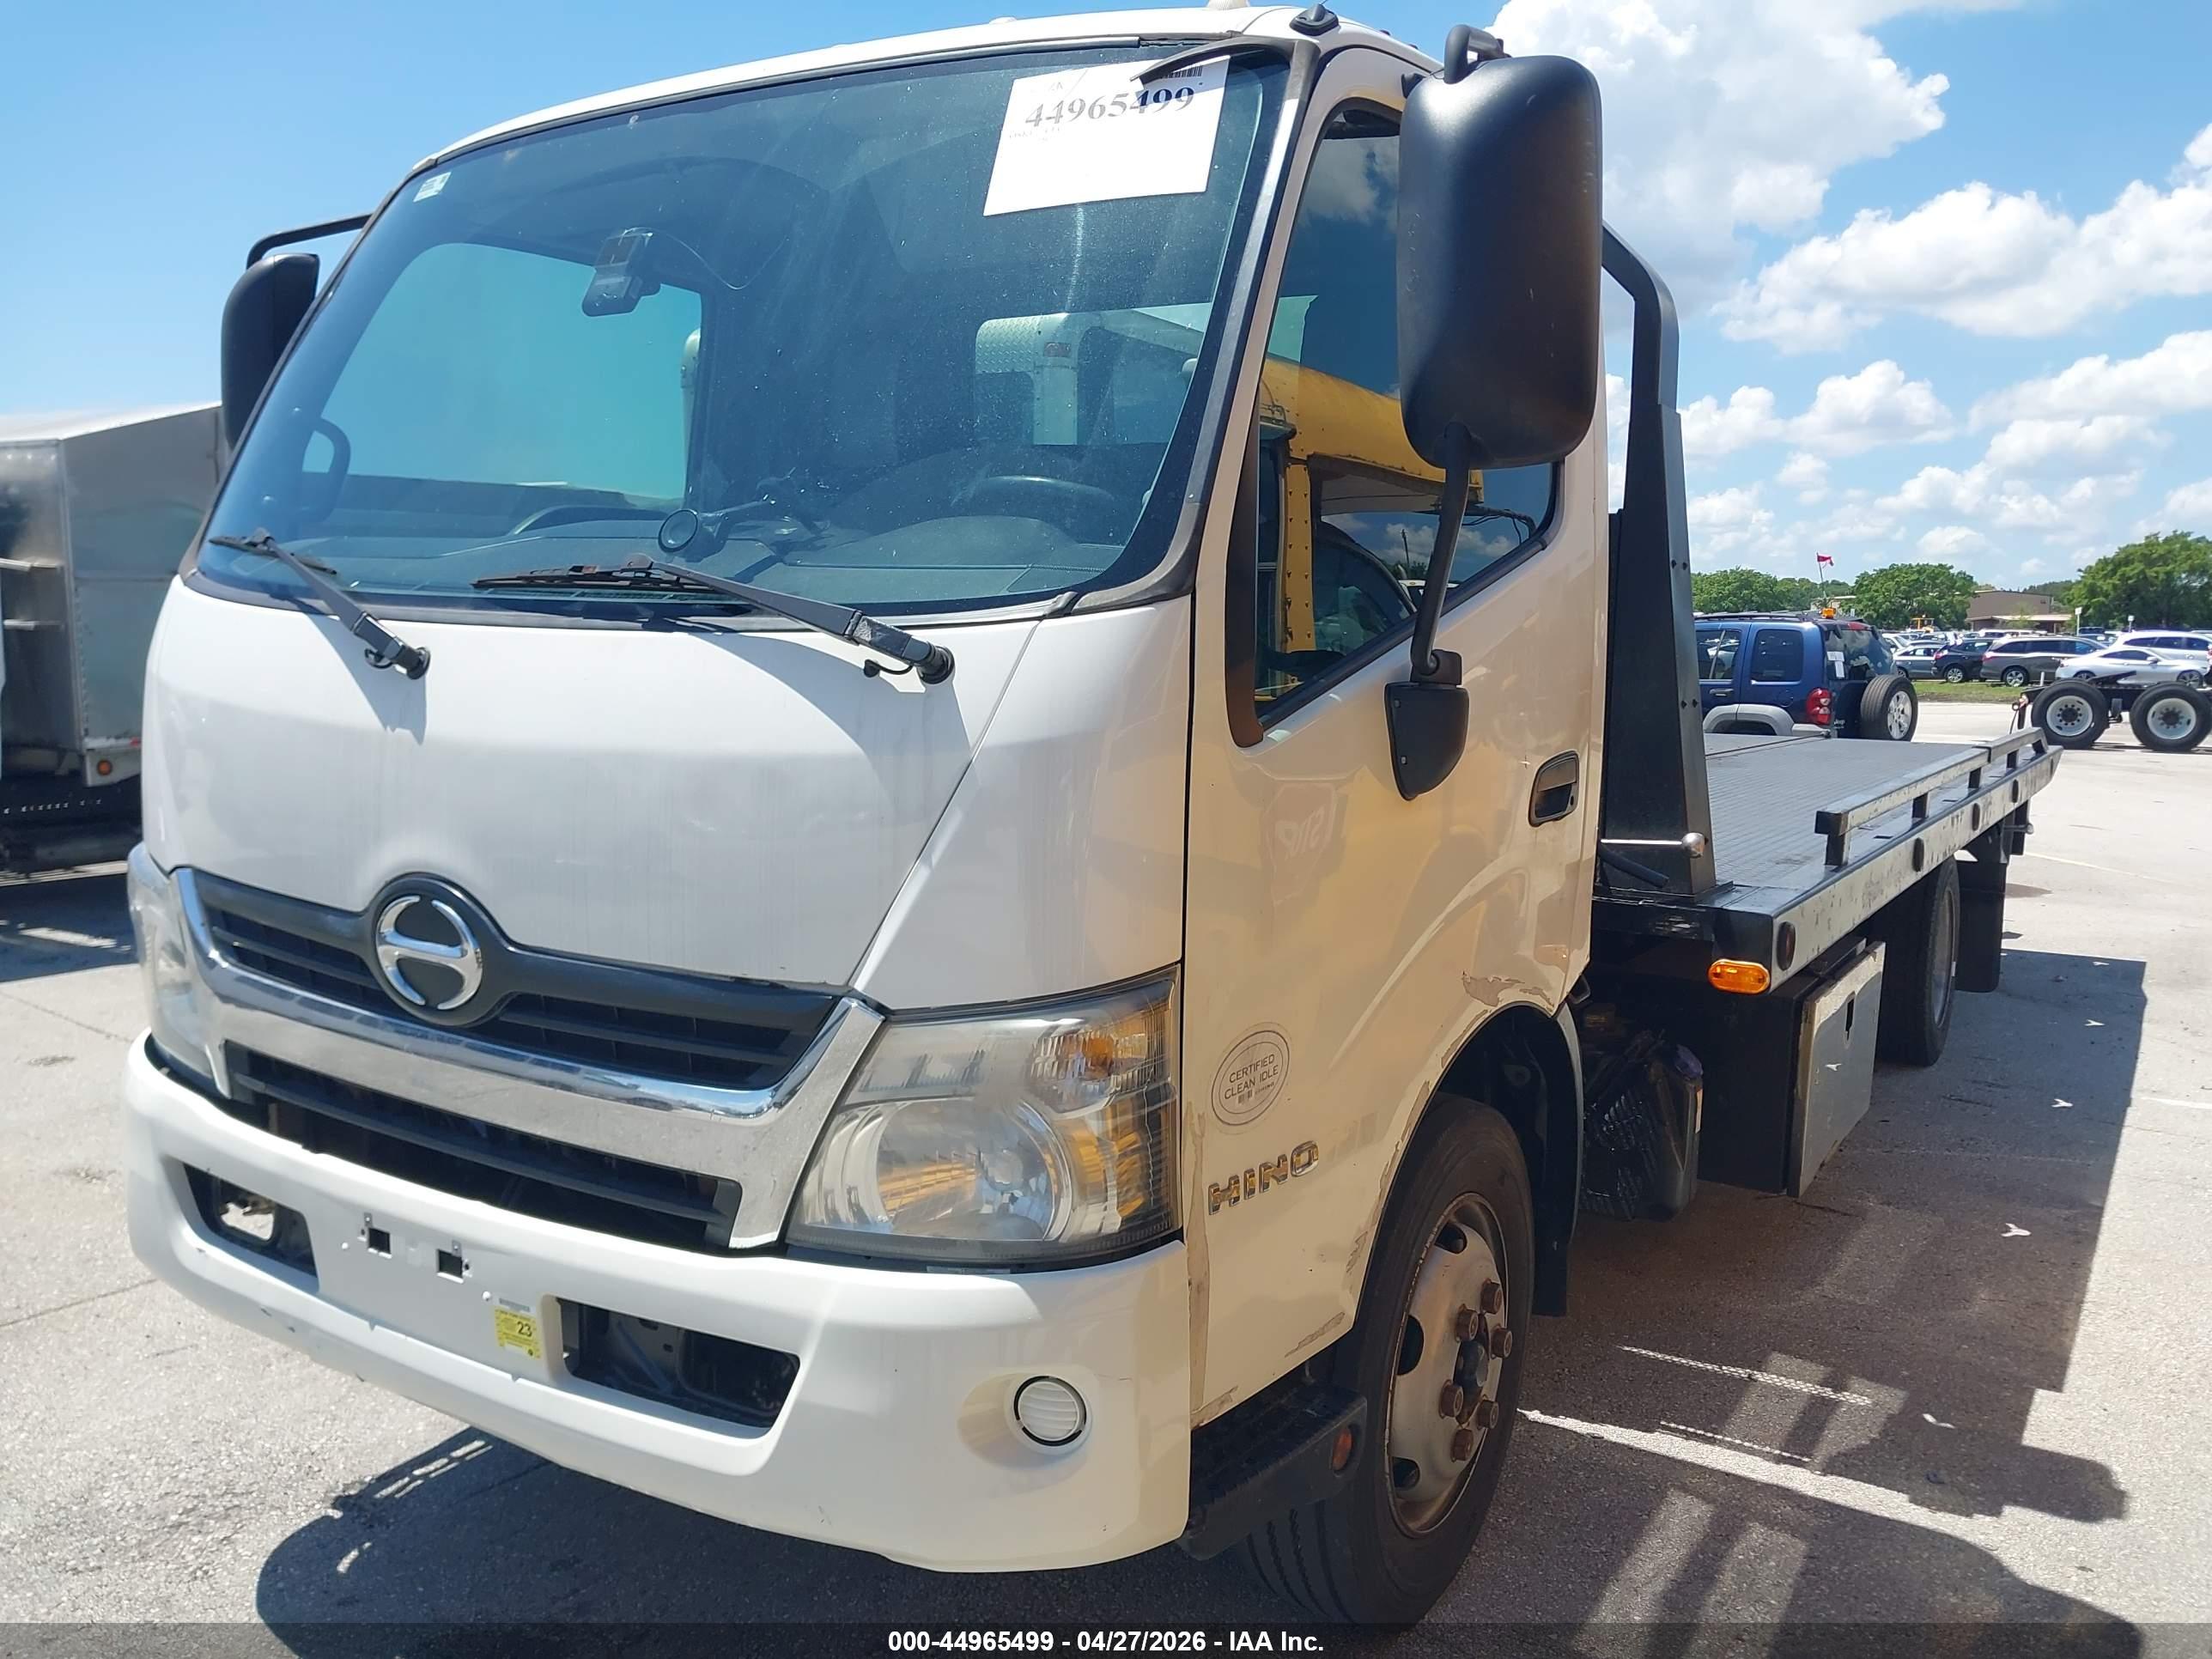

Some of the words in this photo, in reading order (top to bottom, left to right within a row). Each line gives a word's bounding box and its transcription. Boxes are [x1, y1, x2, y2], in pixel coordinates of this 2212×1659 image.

[1024, 87, 1194, 127] 44965499
[1224, 1077, 1255, 1100] CLEAN
[1259, 1064, 1279, 1083] IDLE
[1229, 1054, 1275, 1084] CERTIFIED
[1208, 1140, 1319, 1216] HINO
[517, 1321, 532, 1337] 23
